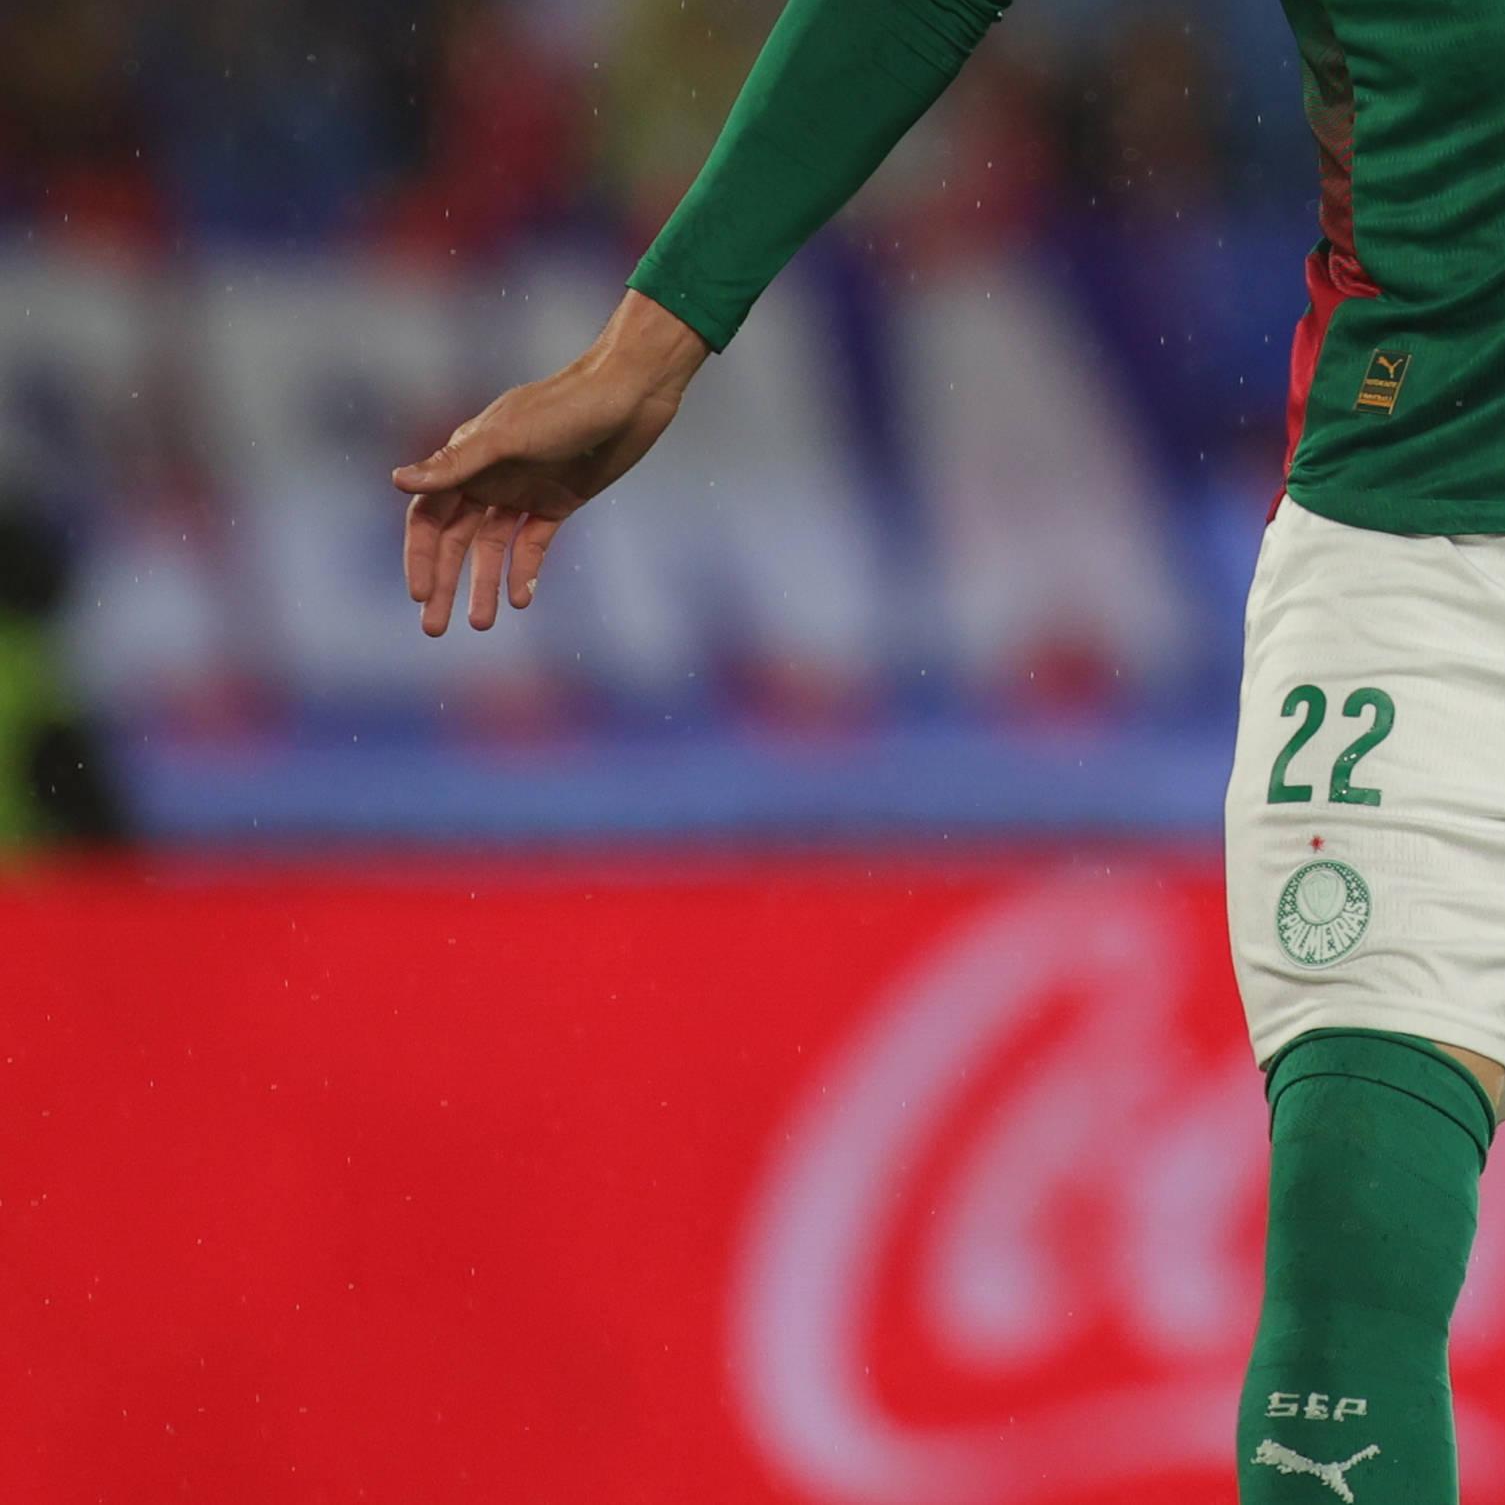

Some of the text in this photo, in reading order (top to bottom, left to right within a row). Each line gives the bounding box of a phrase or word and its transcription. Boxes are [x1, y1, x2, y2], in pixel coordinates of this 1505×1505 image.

[1266, 683, 1396, 807] 22
[1280, 901, 1369, 961] PALMEIRAS
[1264, 1391, 1368, 1422] SEP
